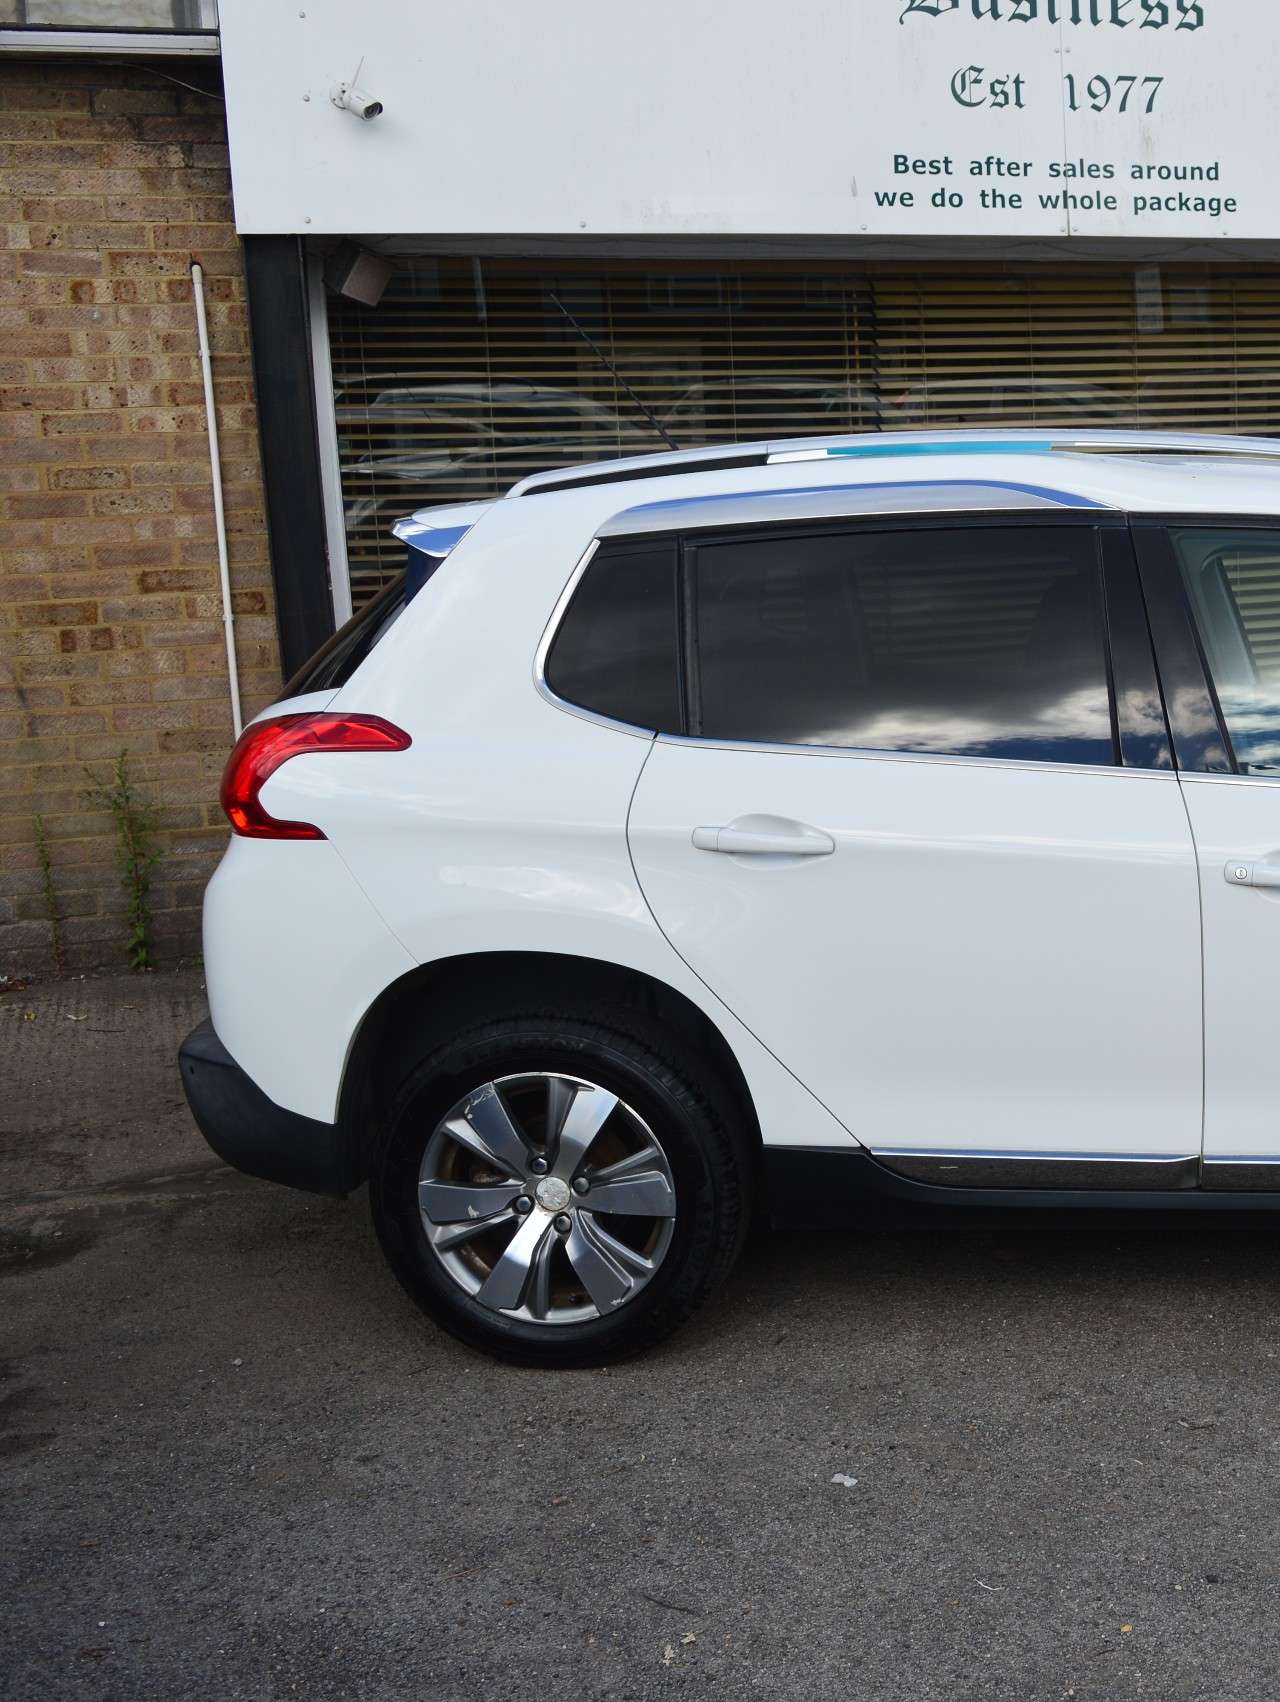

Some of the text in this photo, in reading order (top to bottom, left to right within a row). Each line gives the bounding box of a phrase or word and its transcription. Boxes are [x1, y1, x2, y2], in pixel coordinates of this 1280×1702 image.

[951, 65, 1164, 113] Est 1977
[893, 154, 1219, 181] Best after sales around
[874, 188, 1237, 216] we do the whole package
